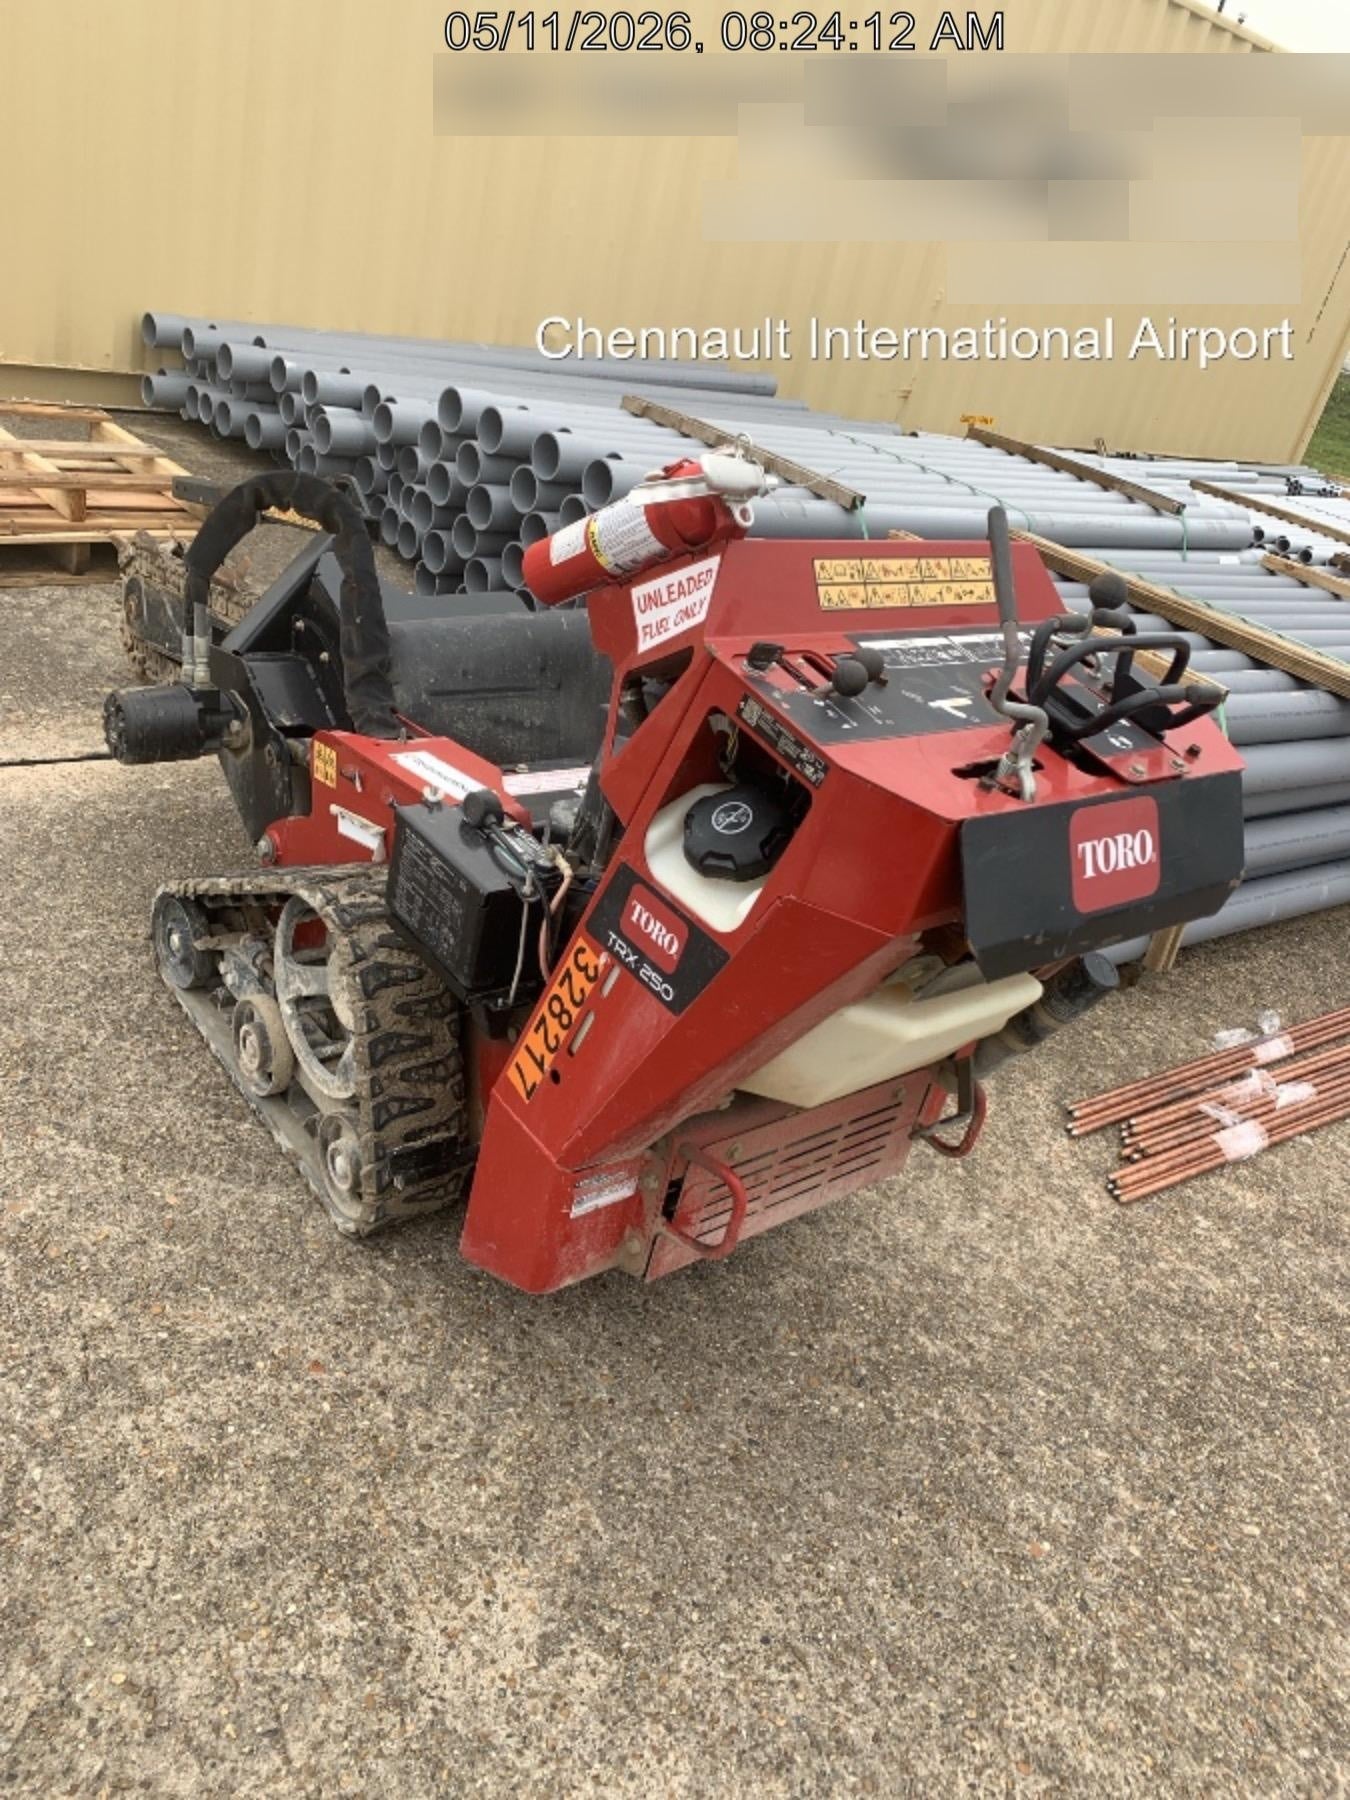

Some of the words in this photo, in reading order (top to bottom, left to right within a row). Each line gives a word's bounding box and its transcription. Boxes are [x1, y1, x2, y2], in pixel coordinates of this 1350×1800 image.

[636, 567, 714, 615] UNLEADED
[641, 615, 671, 644] FUEL
[673, 595, 707, 628] ONLY
[1076, 829, 1154, 880] TORO
[630, 899, 679, 956] TORO
[607, 929, 639, 969] TRX
[638, 962, 674, 1002] 250
[514, 945, 599, 1101] 328217
